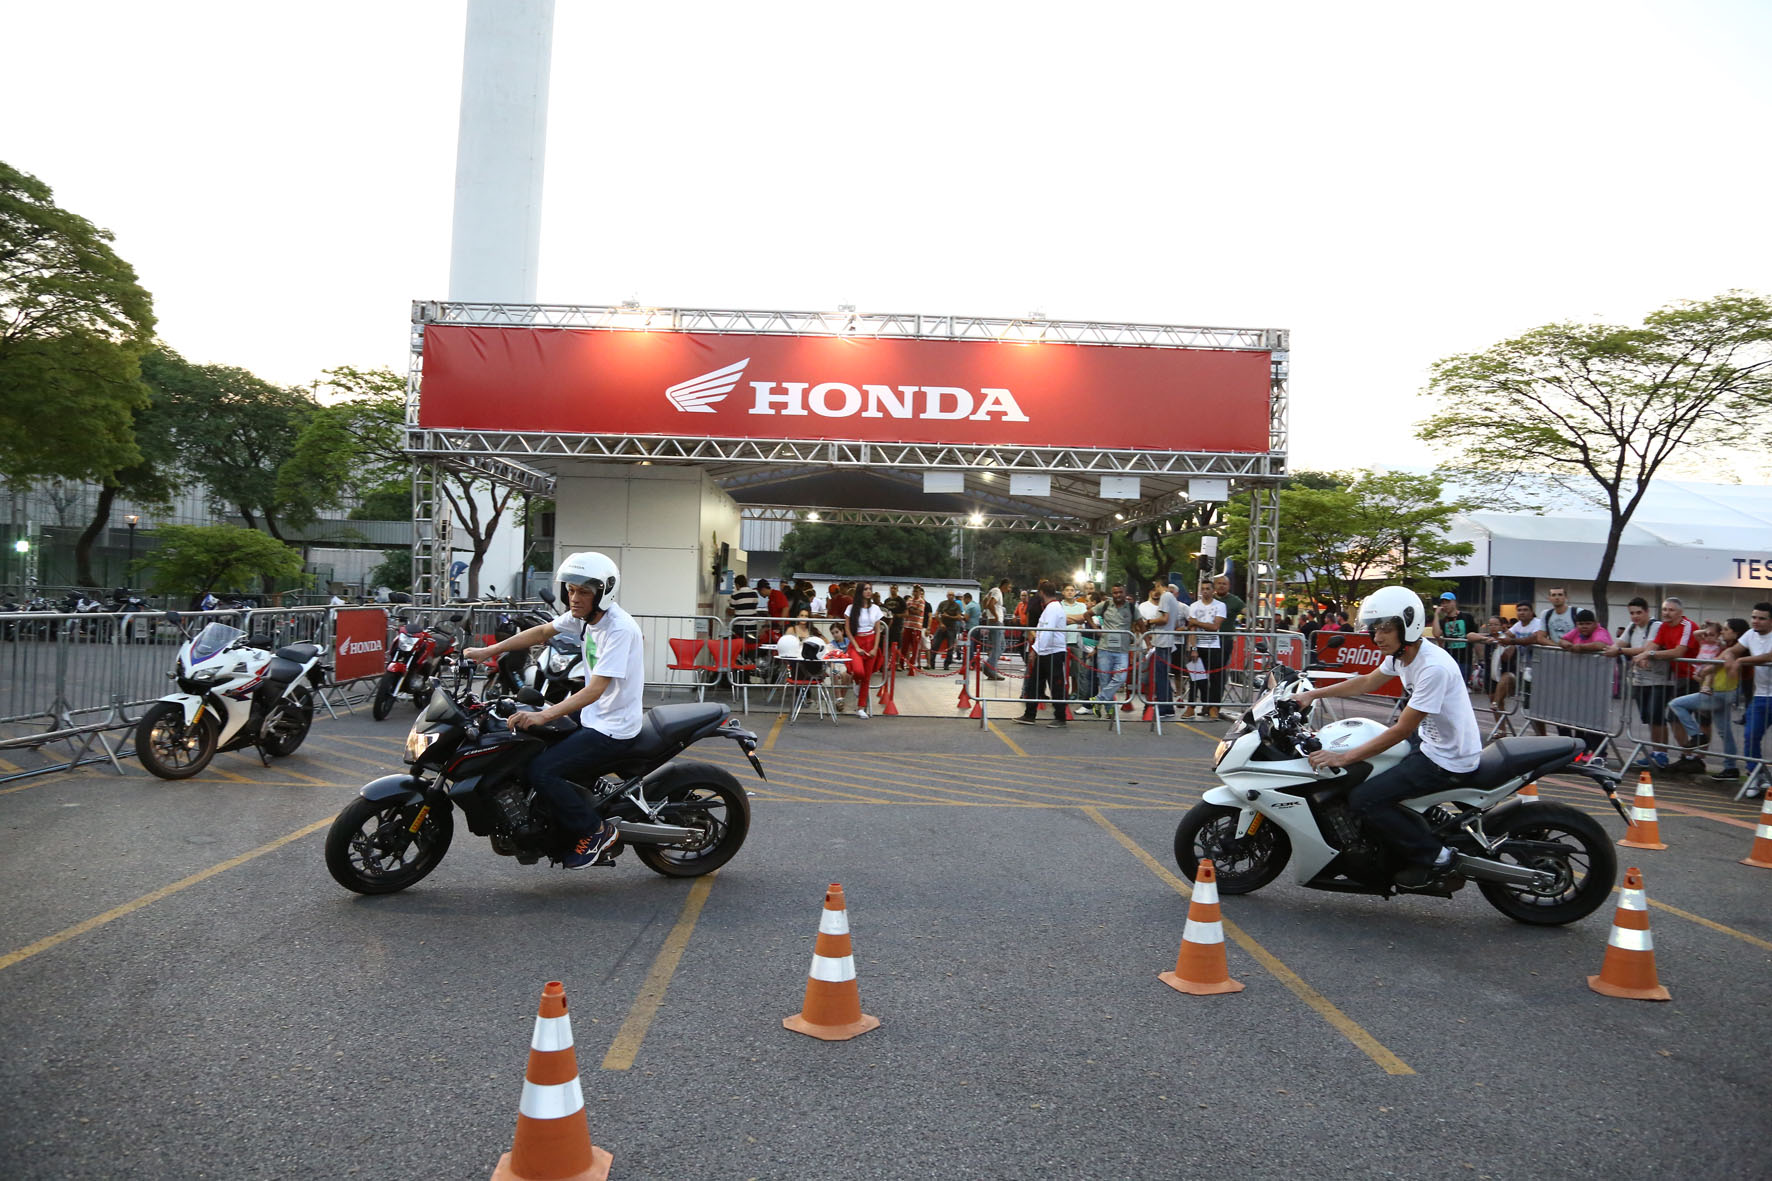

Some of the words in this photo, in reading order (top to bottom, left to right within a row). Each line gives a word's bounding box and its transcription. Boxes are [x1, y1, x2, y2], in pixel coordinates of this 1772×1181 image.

[748, 380, 1030, 422] HONDA
[1731, 558, 1772, 581] TES
[350, 640, 383, 655] HONDA
[1336, 644, 1382, 666] SAÍDA
